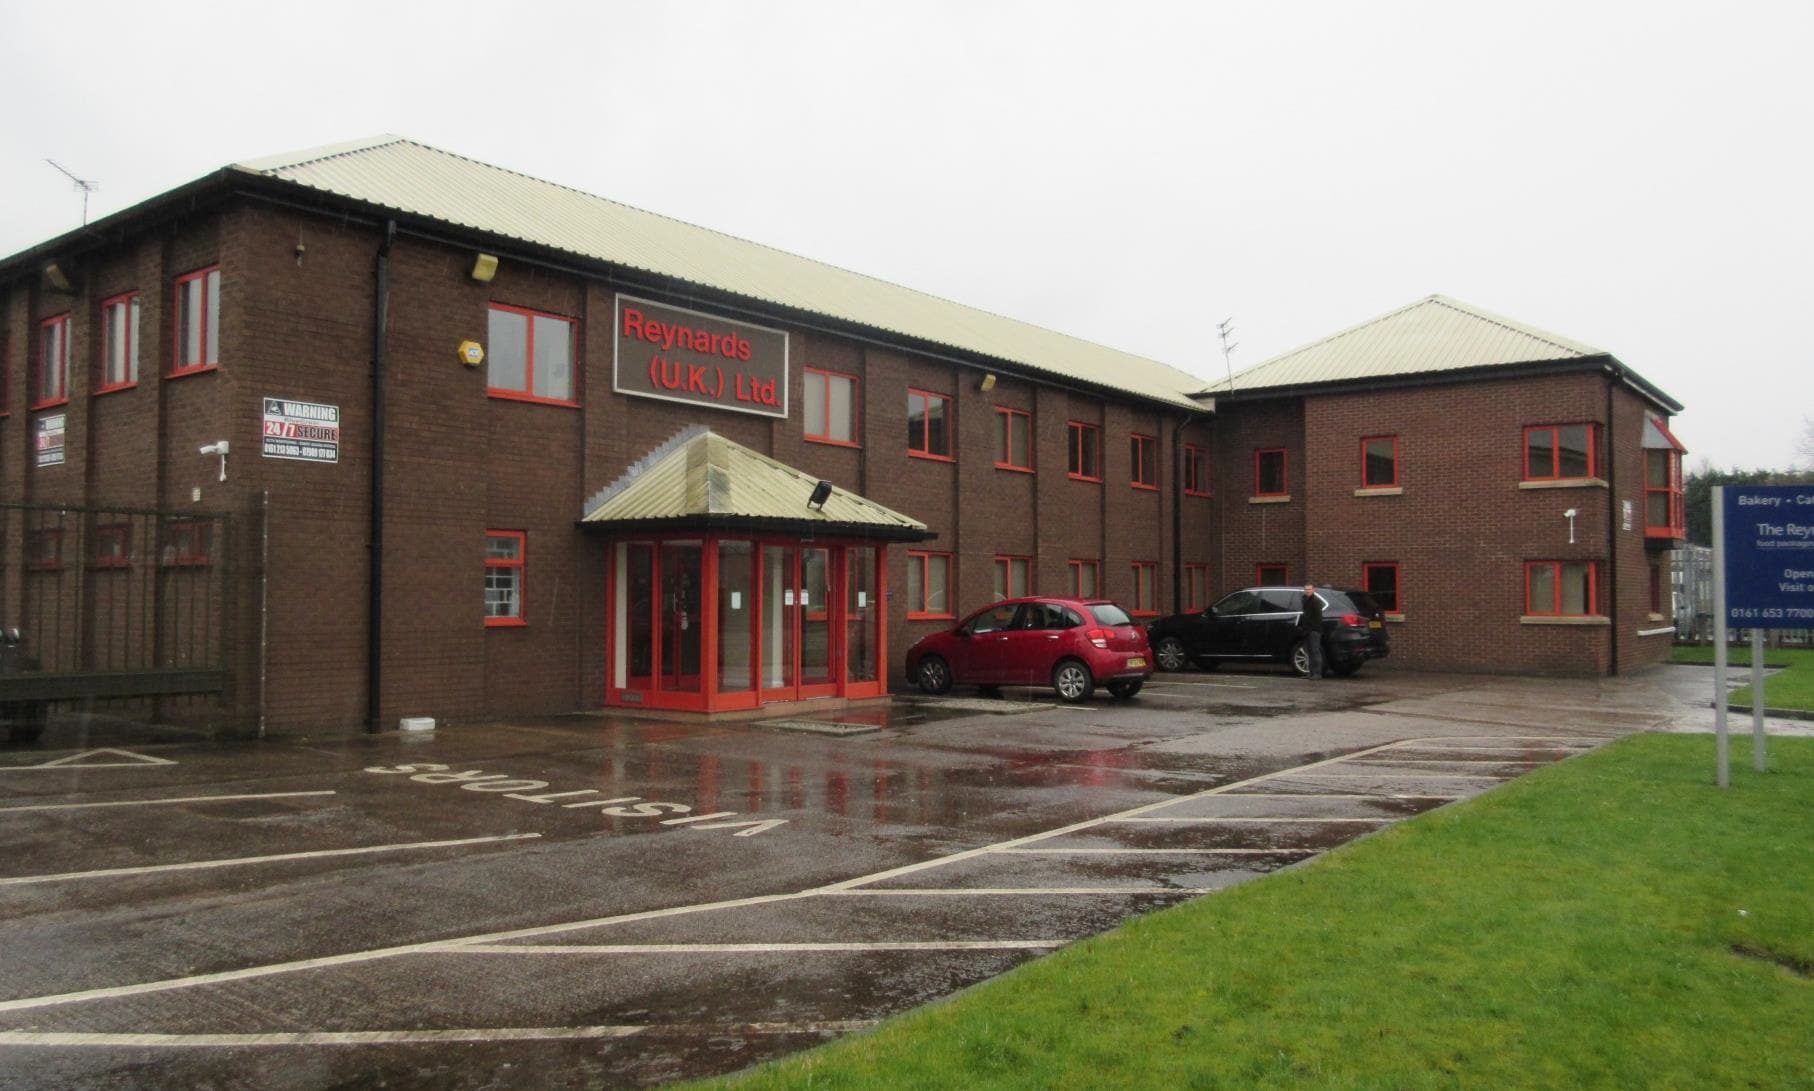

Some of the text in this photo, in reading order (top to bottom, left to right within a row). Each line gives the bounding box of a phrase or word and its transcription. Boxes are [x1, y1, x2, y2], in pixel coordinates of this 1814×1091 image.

[623, 307, 753, 361] Reynards
[649, 354, 725, 398] (U.K.)
[283, 402, 336, 420] WARNING
[265, 421, 296, 438] 24/7
[297, 425, 337, 441] SECURE
[1738, 495, 1781, 507] Bakery
[1757, 523, 1783, 536] The
[1784, 569, 1814, 580] Open
[1778, 582, 1804, 592] Visit
[1731, 608, 1758, 618] 0161
[1762, 608, 1783, 618] 653
[364, 763, 789, 837] VISITORS
